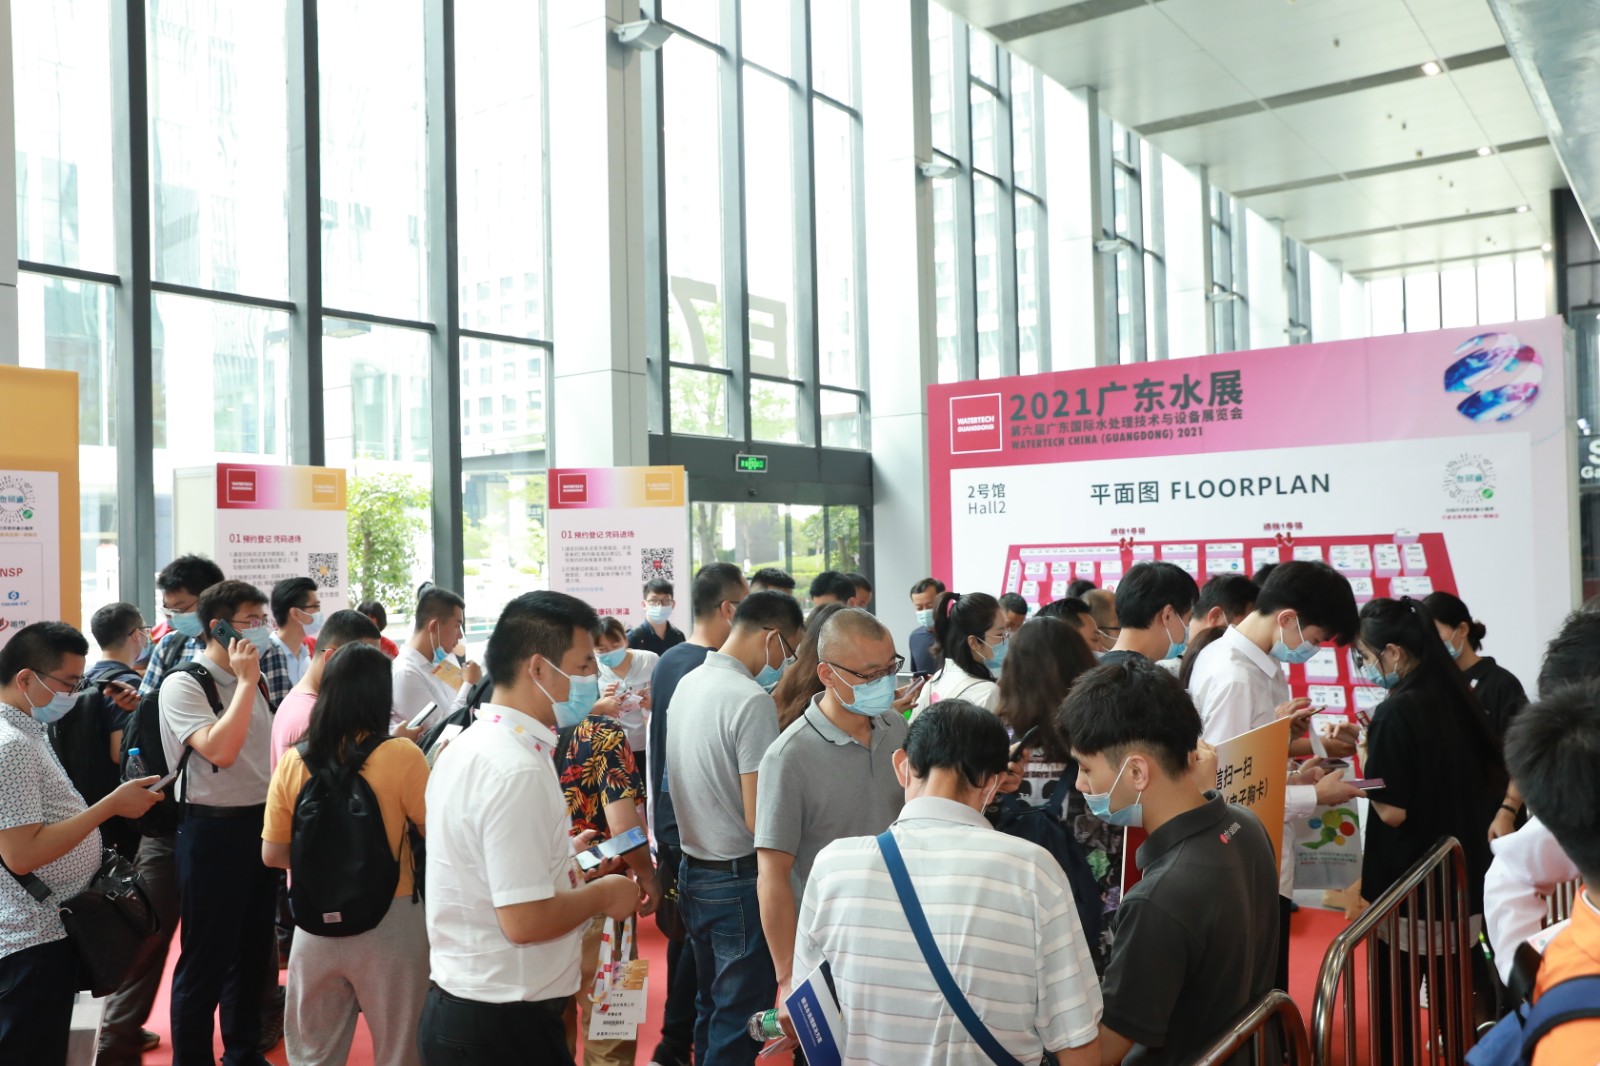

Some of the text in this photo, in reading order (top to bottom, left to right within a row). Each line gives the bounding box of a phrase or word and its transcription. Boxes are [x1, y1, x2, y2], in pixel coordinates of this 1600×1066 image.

[1009, 369, 1243, 421] 2021广东水展
[957, 415, 994, 424] WATERTECH
[1010, 407, 1243, 438] 第六届广东国际水处理技术与设备展览会
[957, 424, 994, 433] GUANGDONG
[1011, 427, 1203, 450] WATERTECH CHINA (GUANGDONG) 2021
[967, 483, 1006, 499] 2号馆
[1090, 473, 1331, 506] 平面图 FLOORPLAN
[968, 500, 1007, 515] Hall2
[229, 534, 241, 543] 01
[561, 530, 635, 539] 01 预约登记 凭码进场
